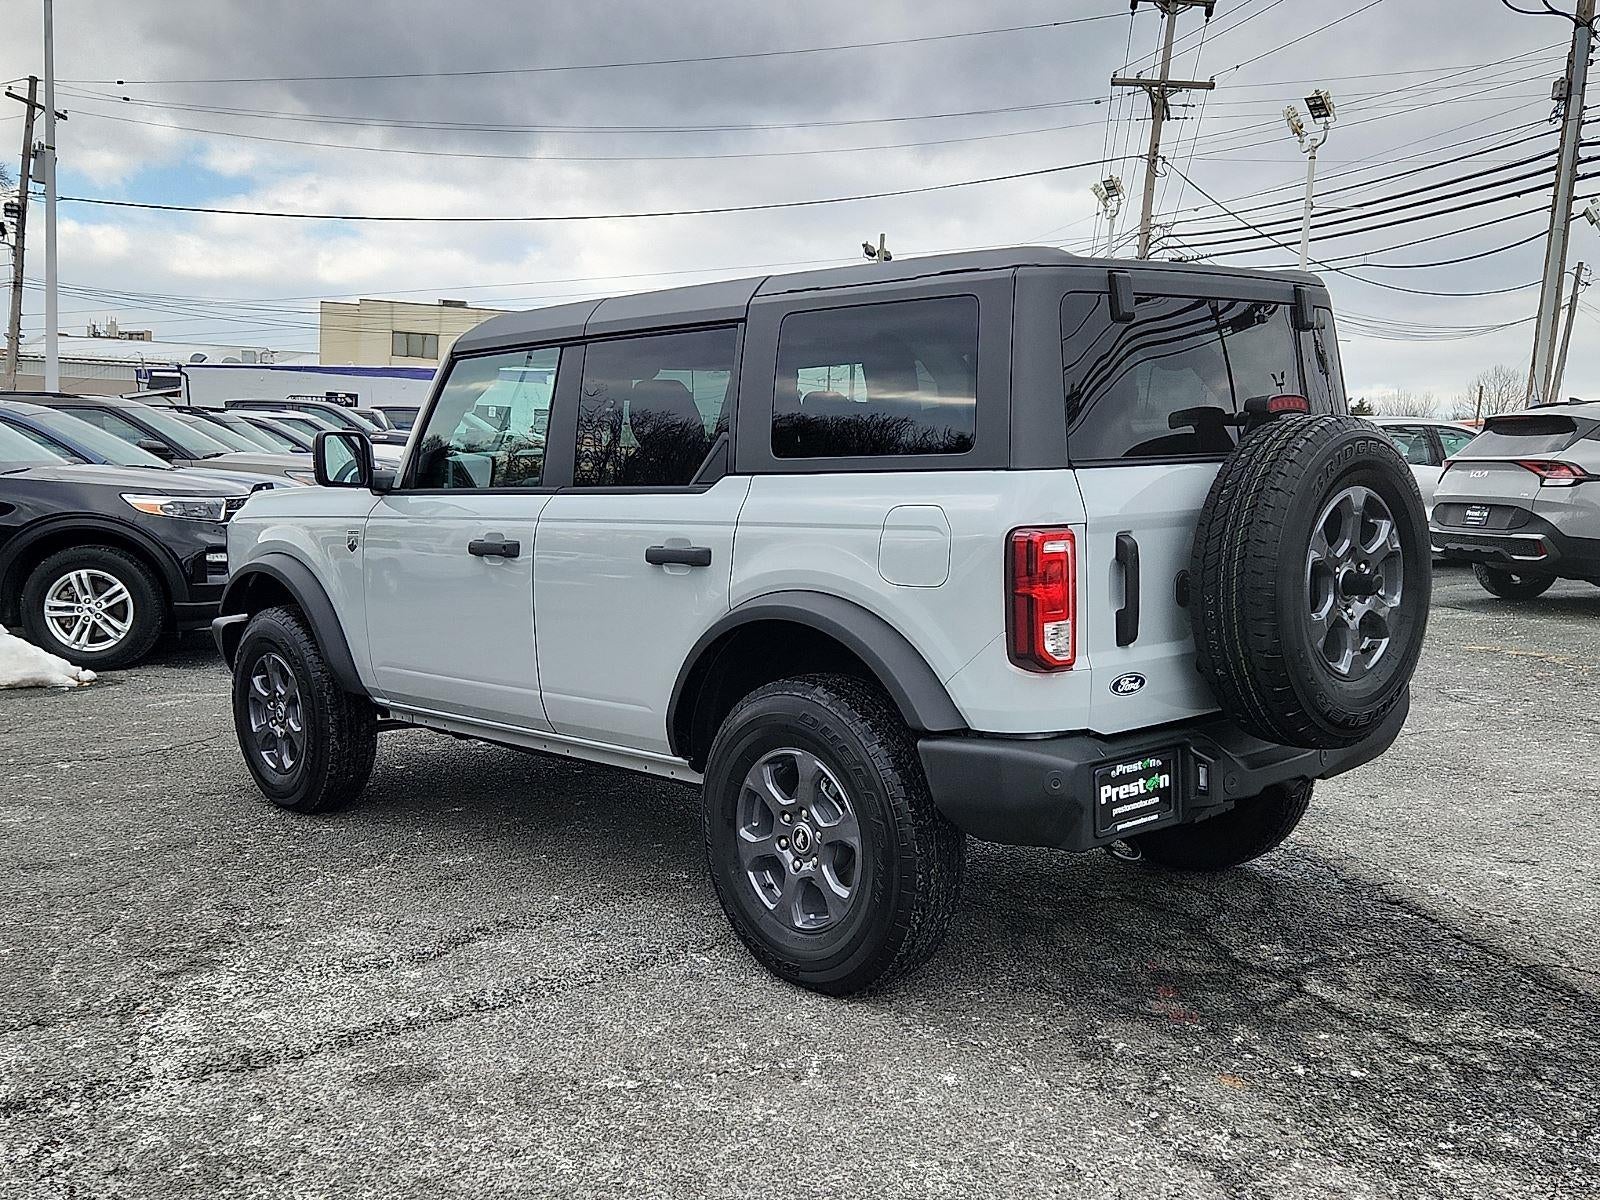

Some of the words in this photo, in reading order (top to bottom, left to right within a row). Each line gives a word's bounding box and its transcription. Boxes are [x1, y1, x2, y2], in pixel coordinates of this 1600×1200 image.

[1118, 677, 1141, 692] Ford
[1116, 758, 1156, 775] Preston
[798, 712, 886, 849] DUELER
[1100, 773, 1170, 805] Preston
[1112, 796, 1160, 817] prestonmotor.com
